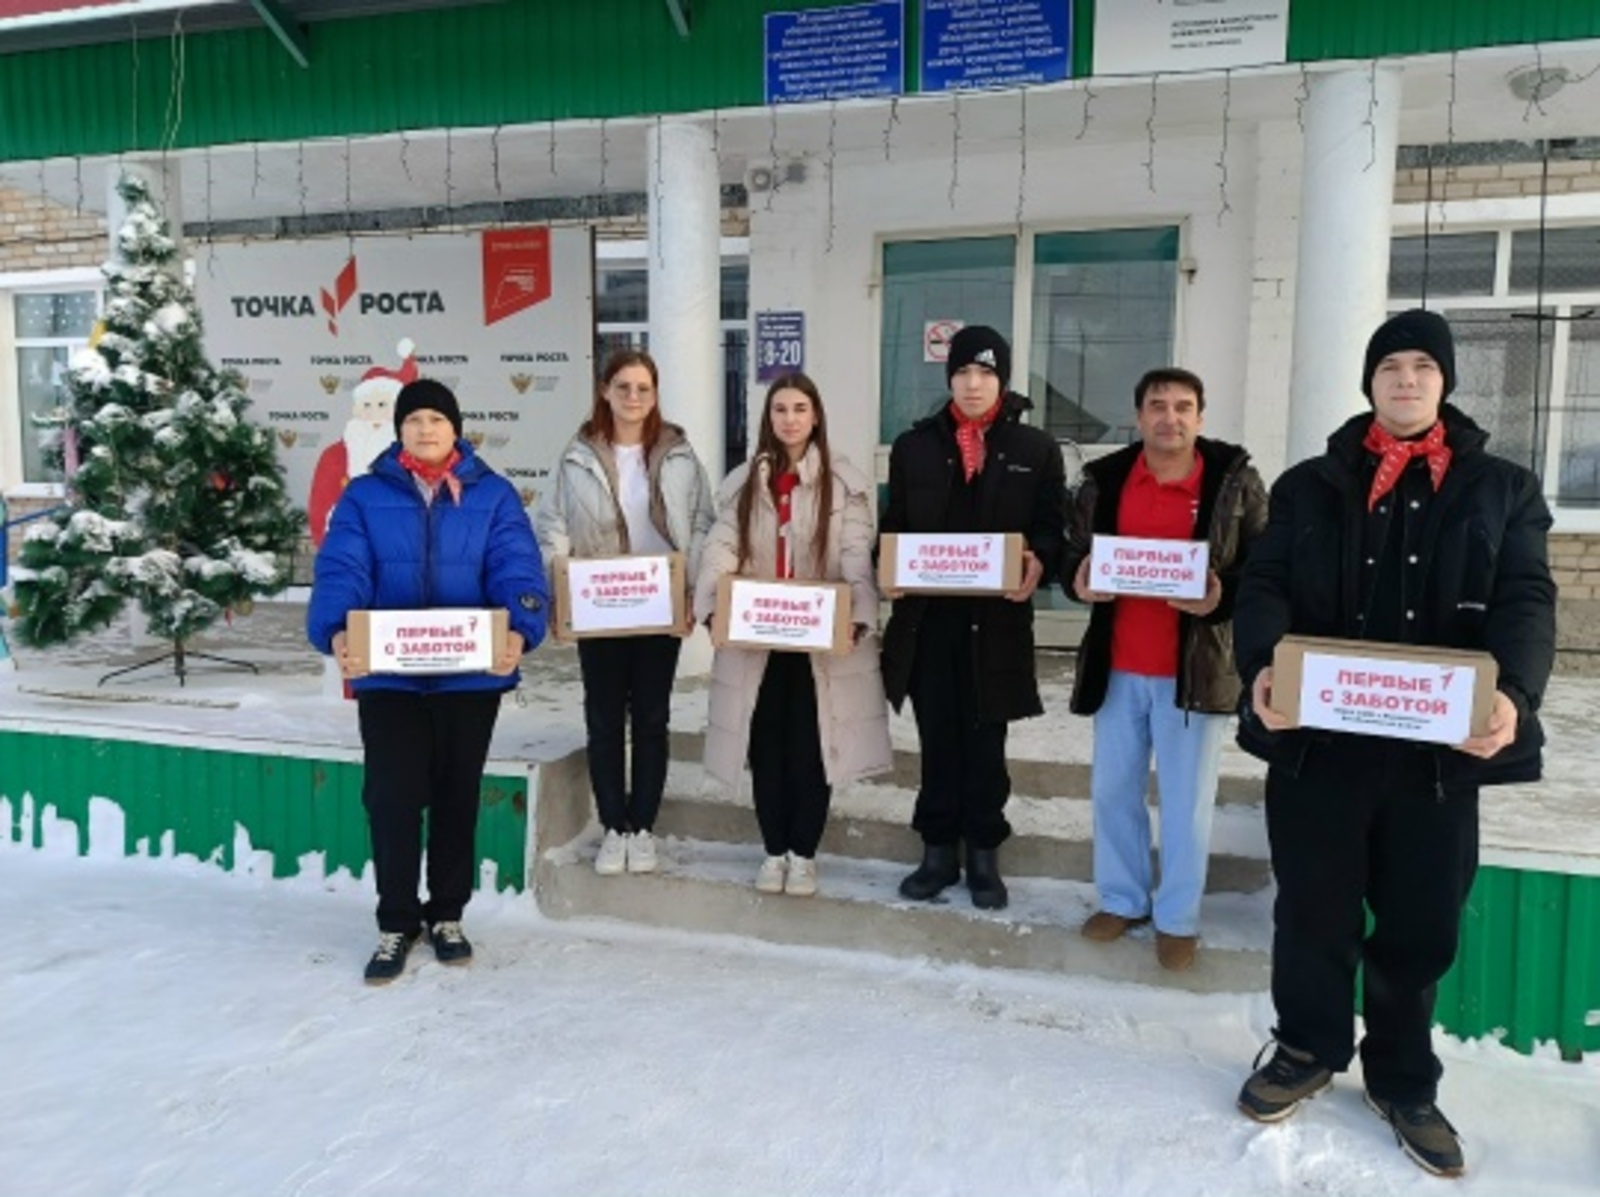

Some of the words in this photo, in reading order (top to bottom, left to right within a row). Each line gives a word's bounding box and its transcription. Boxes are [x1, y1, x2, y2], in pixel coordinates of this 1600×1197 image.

[230, 295, 316, 318] ТОЧКА
[359, 291, 445, 315] РОСТА
[536, 352, 569, 363] РОСТА
[917, 545, 979, 558] ПЕРВЫЕ
[1113, 547, 1184, 564] ПЕРВЫЕ
[921, 560, 991, 573] ЗАБОТОЙ
[1116, 565, 1195, 582] ЗАБОТОЙ
[589, 571, 648, 585] ПЕРВЫЕ
[595, 584, 659, 597] ЗАБОТОЙ
[751, 598, 812, 612] ПЕРВЫЕ
[754, 613, 822, 627] ЗАБОТОЙ
[395, 624, 465, 638] ПЕРВЫЕ
[400, 641, 477, 656] ЗАБОТОЙ
[1336, 669, 1433, 693] ПЕРВЫЕ
[1341, 690, 1448, 716] ЗАБОТОЙ
